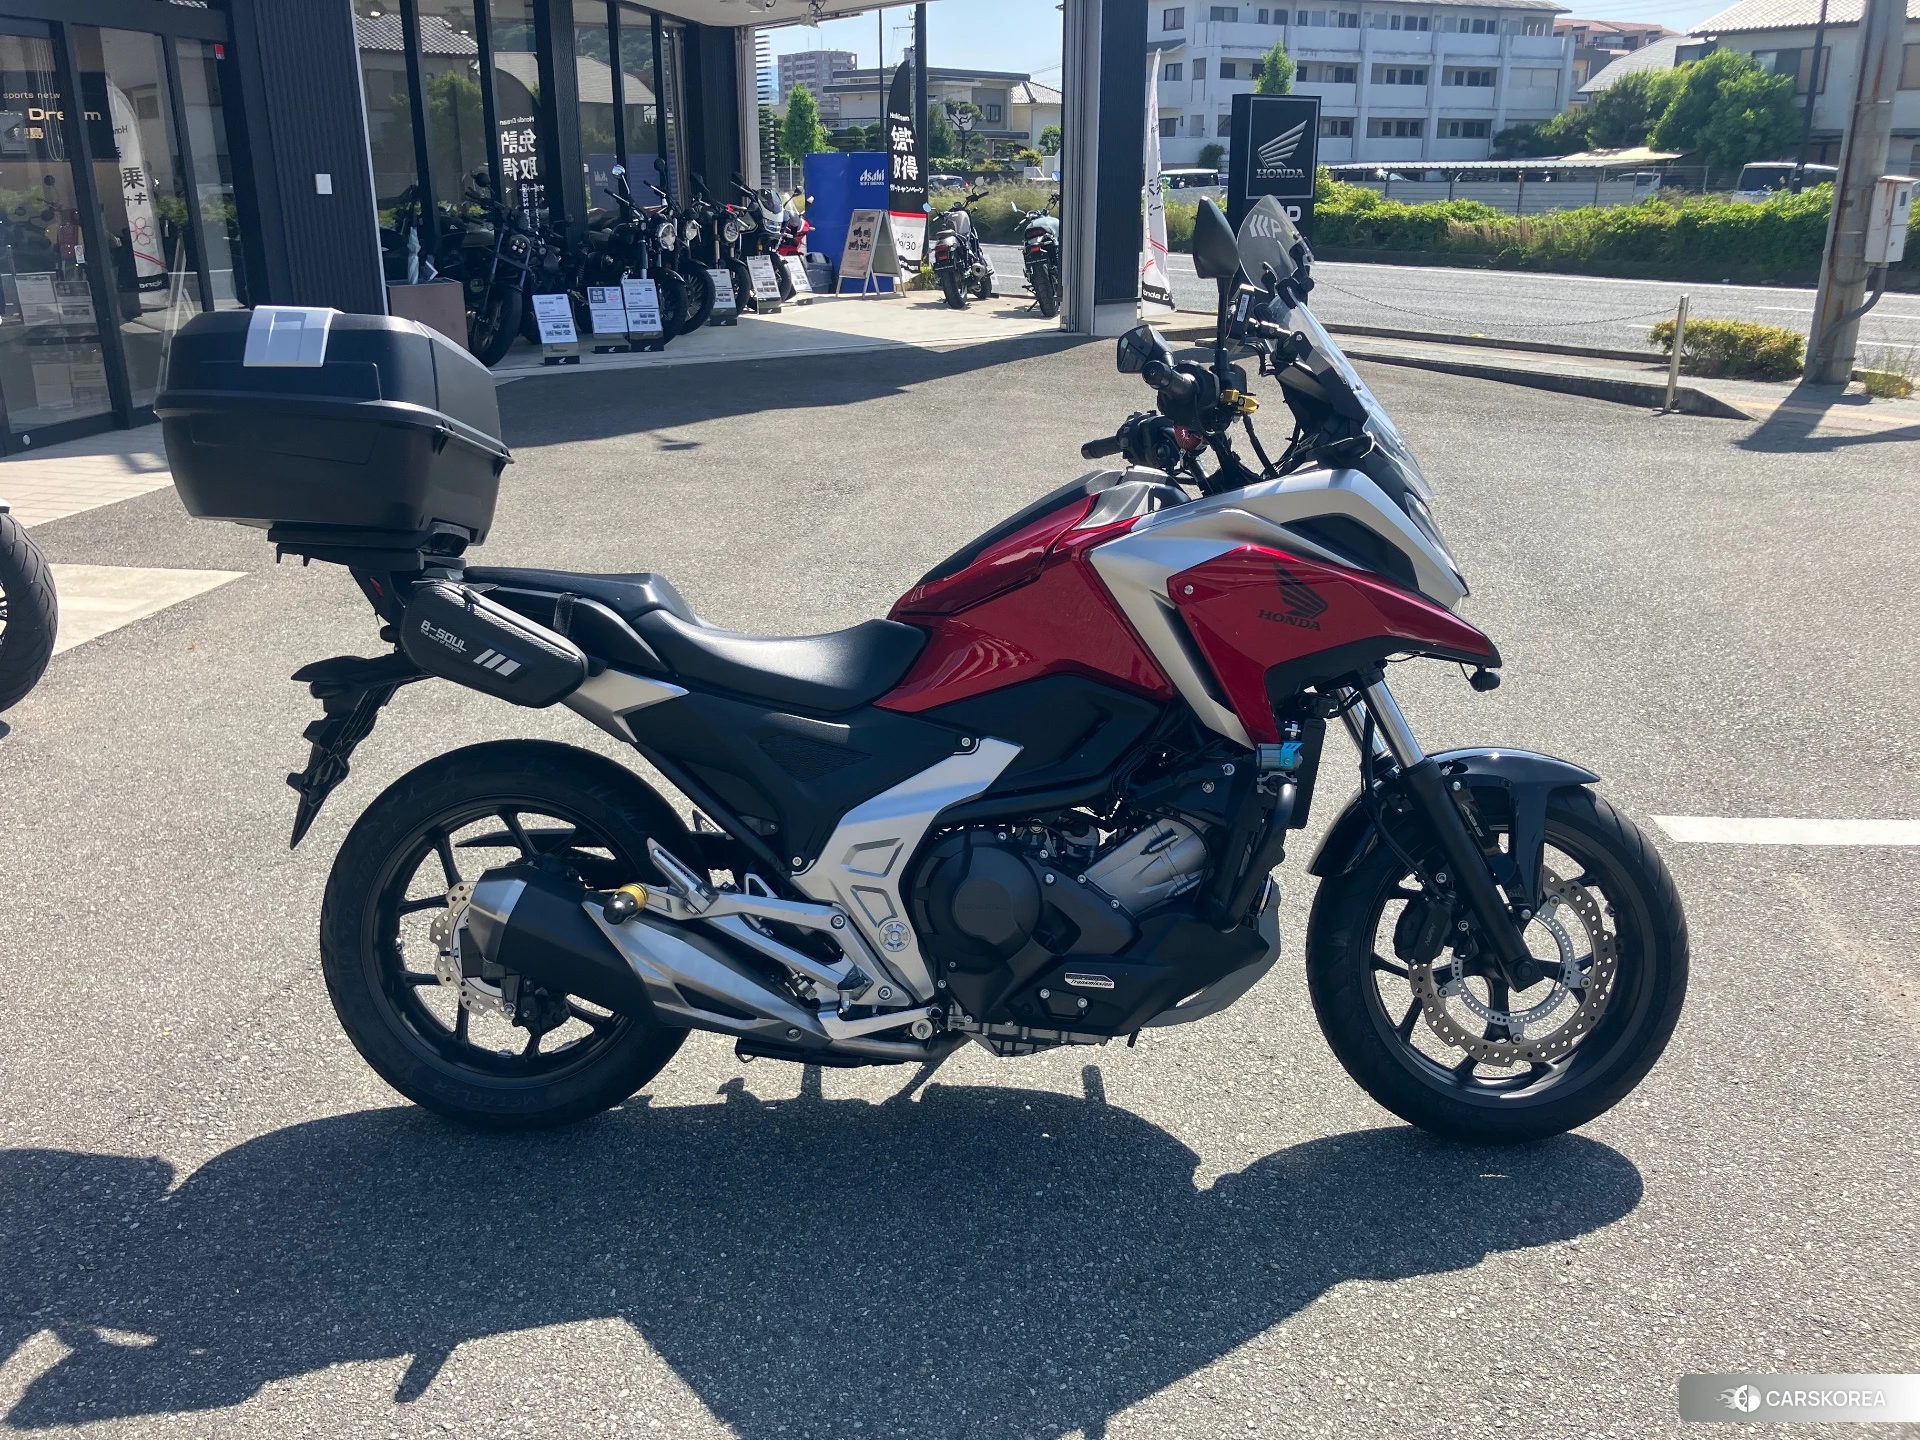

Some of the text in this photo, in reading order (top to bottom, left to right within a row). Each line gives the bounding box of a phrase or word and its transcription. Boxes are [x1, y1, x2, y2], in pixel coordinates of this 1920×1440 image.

[860, 168, 885, 182] Asahi
[1256, 168, 1306, 179] HONDA
[1257, 609, 1322, 632] HONDA
[421, 620, 466, 652] B-SOUL
[1070, 979, 1113, 987] Transmission
